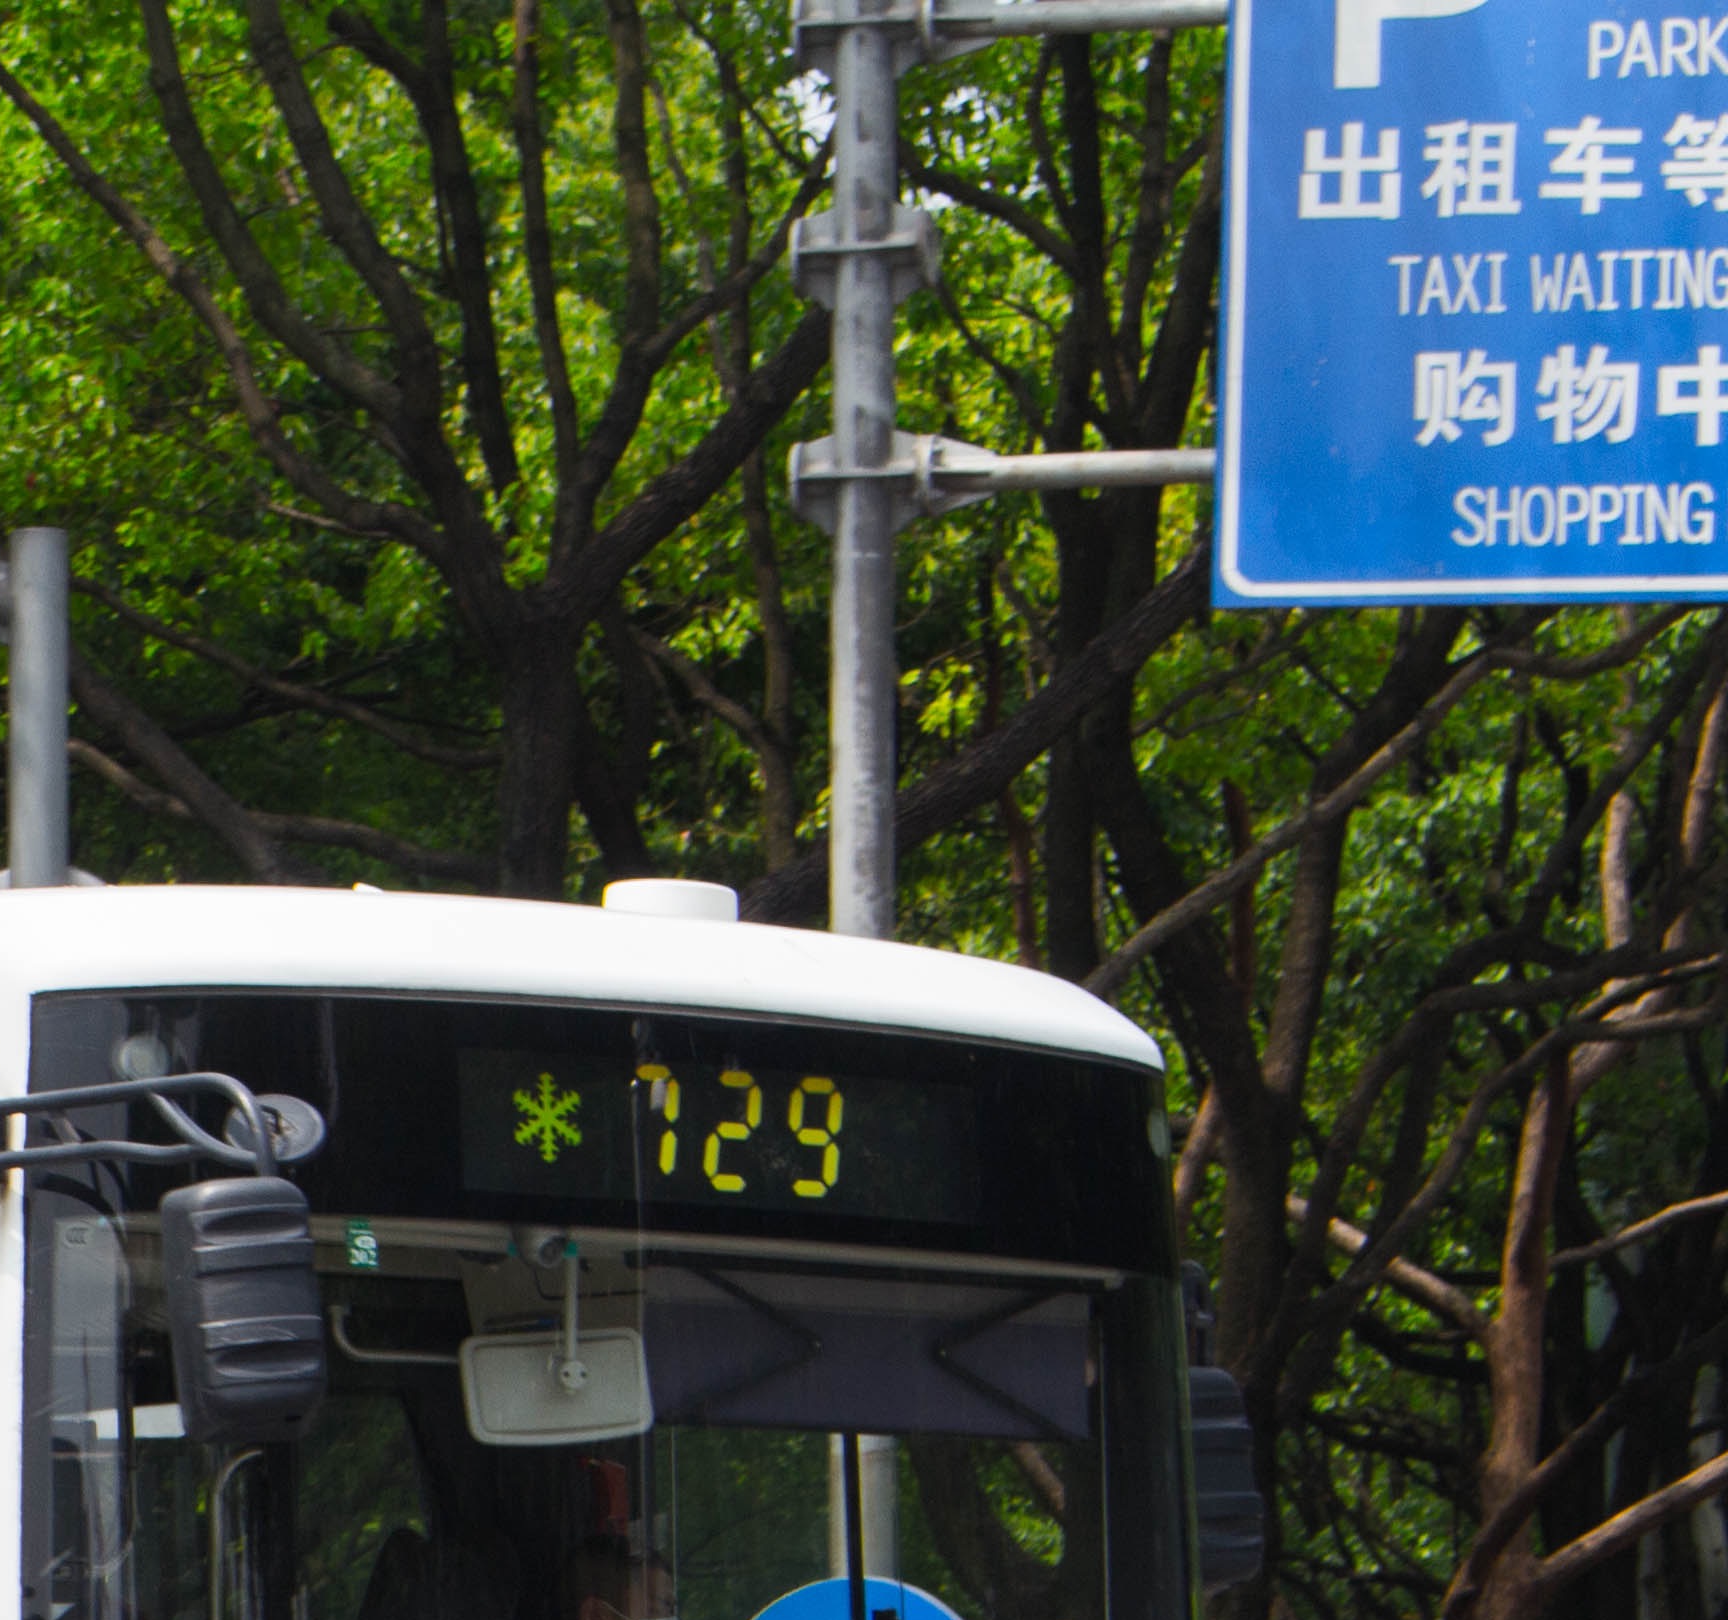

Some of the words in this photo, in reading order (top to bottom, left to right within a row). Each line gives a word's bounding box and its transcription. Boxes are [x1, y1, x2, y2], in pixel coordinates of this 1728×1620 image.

[1298, 112, 1728, 219] 出租车等
[1388, 252, 1507, 315] TAXI
[1530, 247, 1728, 313] WAITING
[1413, 344, 1728, 447] 购物中
[1451, 481, 1715, 548] SHOPPING
[636, 1063, 844, 1197] 729
